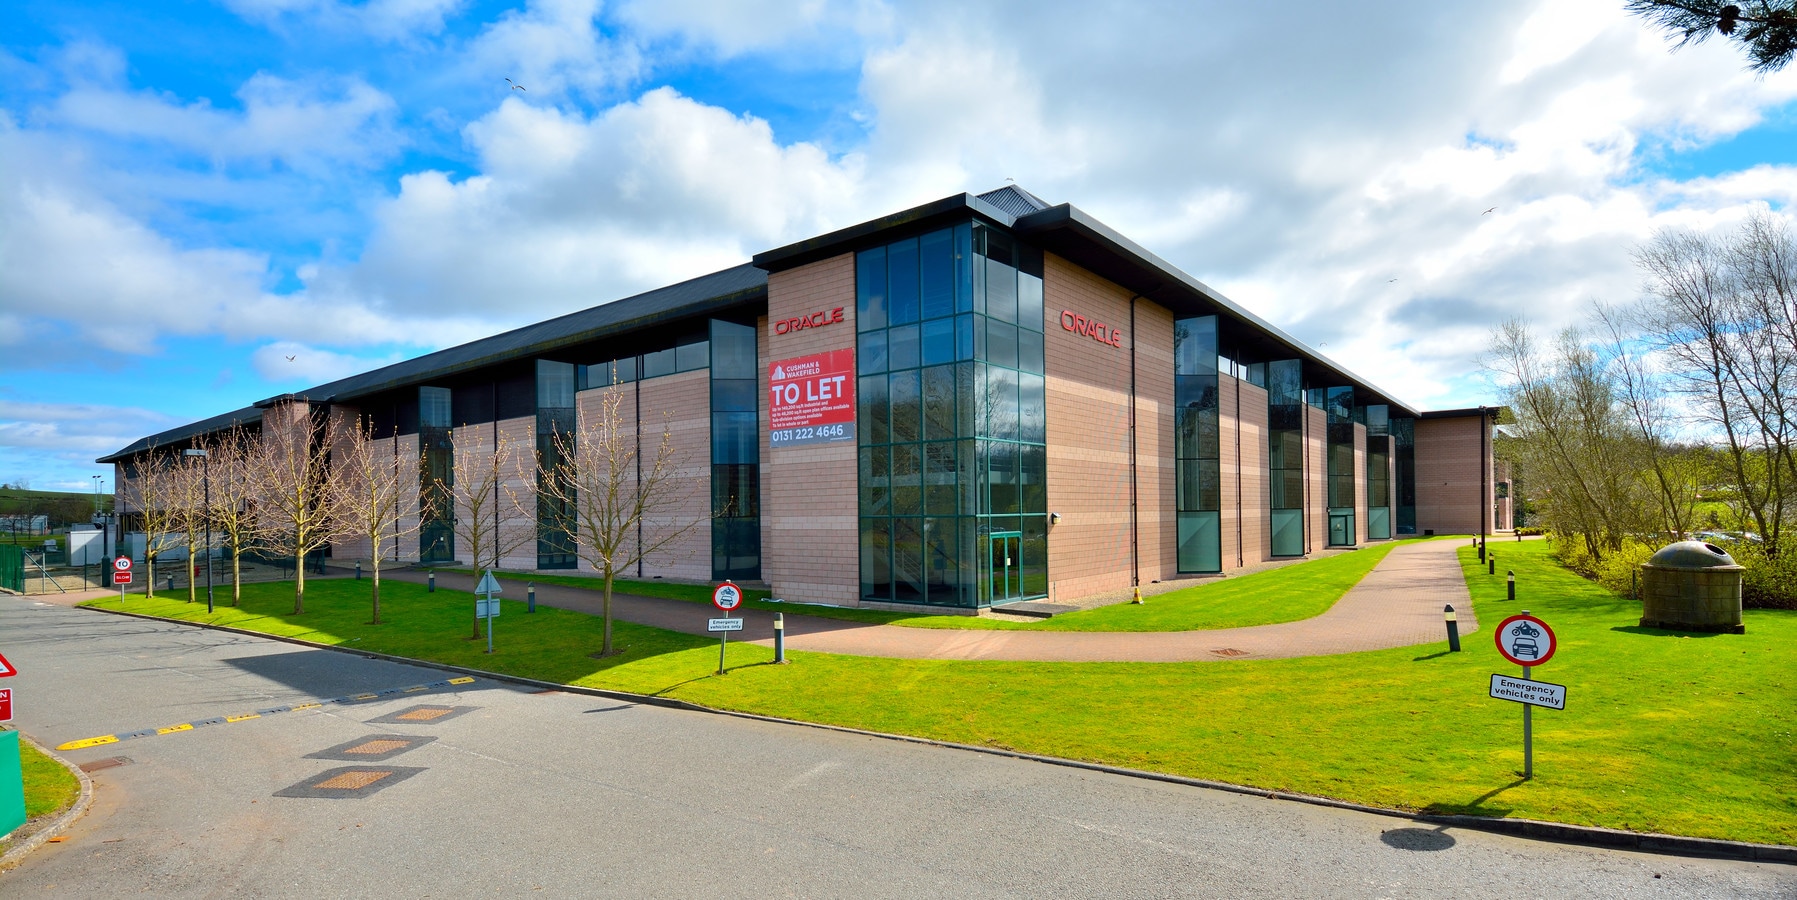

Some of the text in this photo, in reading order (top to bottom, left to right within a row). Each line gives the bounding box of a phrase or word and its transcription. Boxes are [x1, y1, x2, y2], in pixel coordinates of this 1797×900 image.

[774, 307, 844, 335] ORACLE
[1061, 310, 1122, 348] ORACLE
[786, 362, 815, 372] CUSHMAN
[786, 367, 820, 379] WAKEFIELD
[772, 375, 846, 406] TO LET
[772, 424, 843, 442] 0131 222 4646
[1500, 679, 1555, 695] Emergency
[1494, 688, 1560, 705] vehicles only
